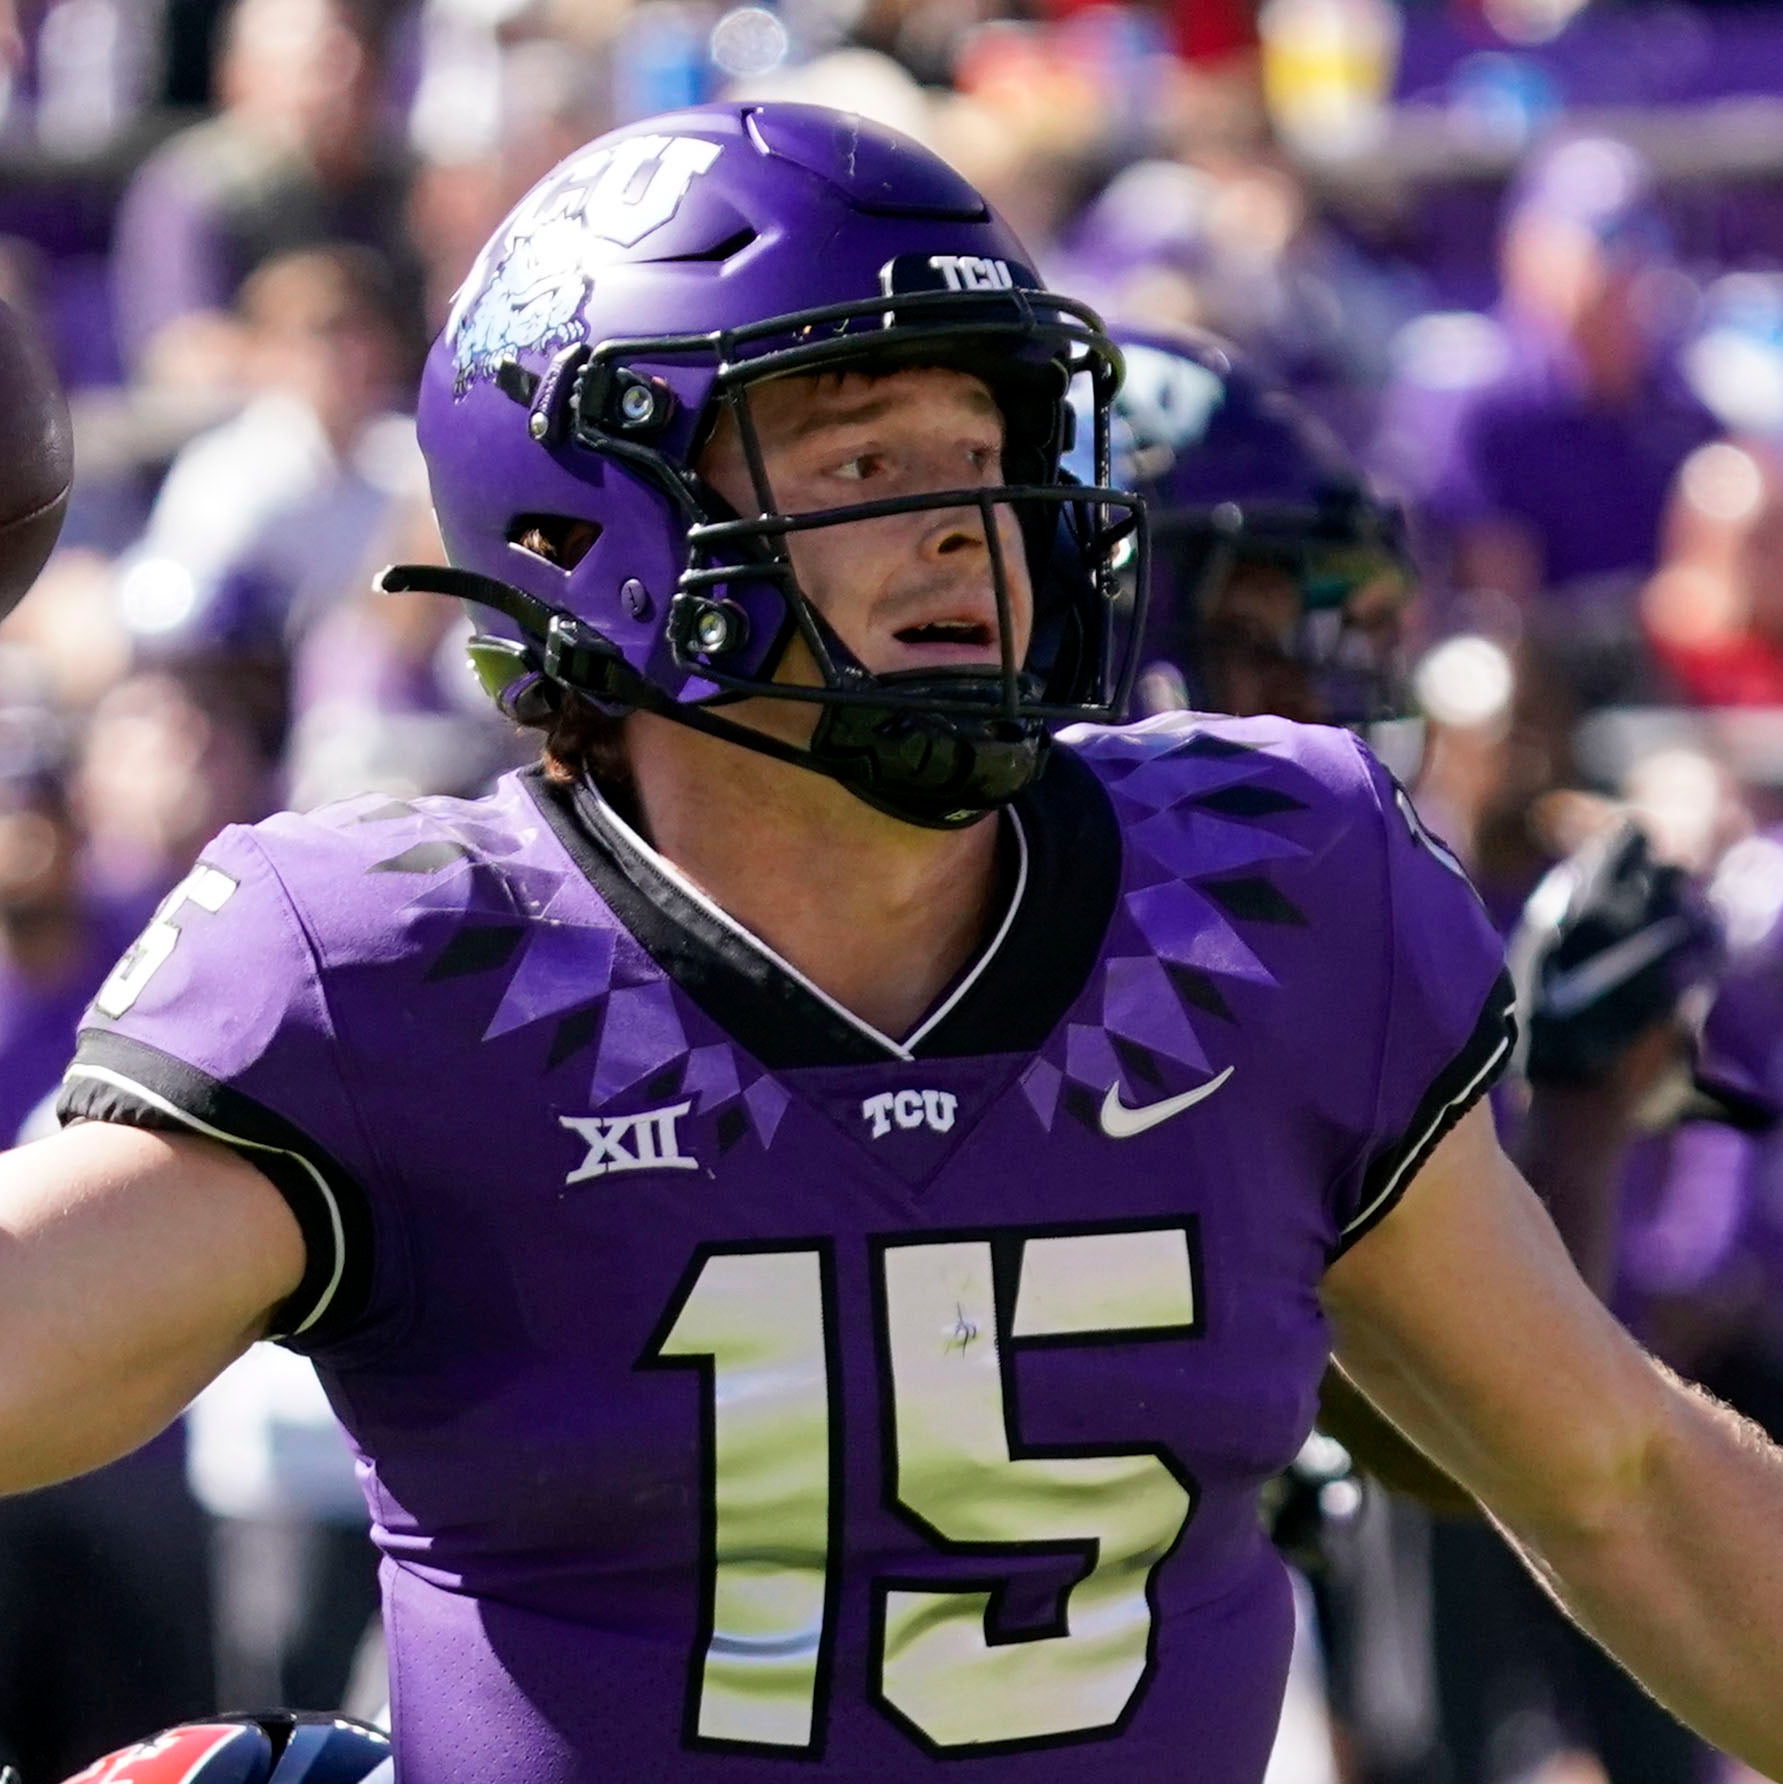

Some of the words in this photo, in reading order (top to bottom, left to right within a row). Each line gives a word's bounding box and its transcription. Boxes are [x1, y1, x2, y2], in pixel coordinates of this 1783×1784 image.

[928, 255, 1014, 291] TCU
[557, 1099, 700, 1185] XII
[861, 1087, 960, 1141] TCU
[631, 1212, 1206, 1761] 15
